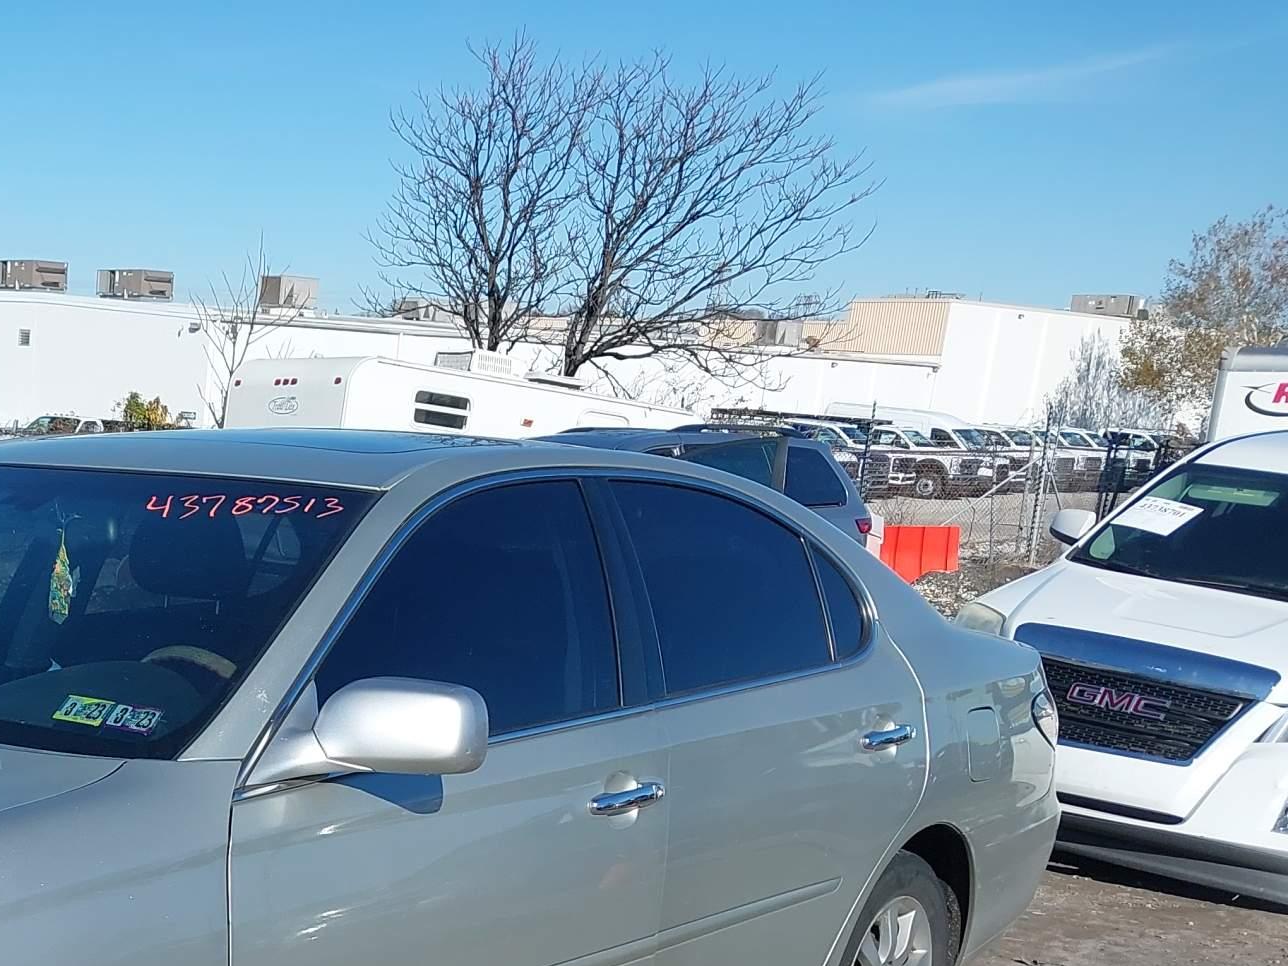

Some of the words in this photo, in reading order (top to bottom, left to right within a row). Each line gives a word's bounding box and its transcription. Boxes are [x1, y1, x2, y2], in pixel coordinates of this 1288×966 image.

[146, 495, 344, 519] 43787513
[63, 702, 78, 717] 3
[86, 703, 107, 721] 23
[1067, 681, 1171, 720] GMC
[113, 707, 129, 724] 3
[135, 710, 157, 729] 23
